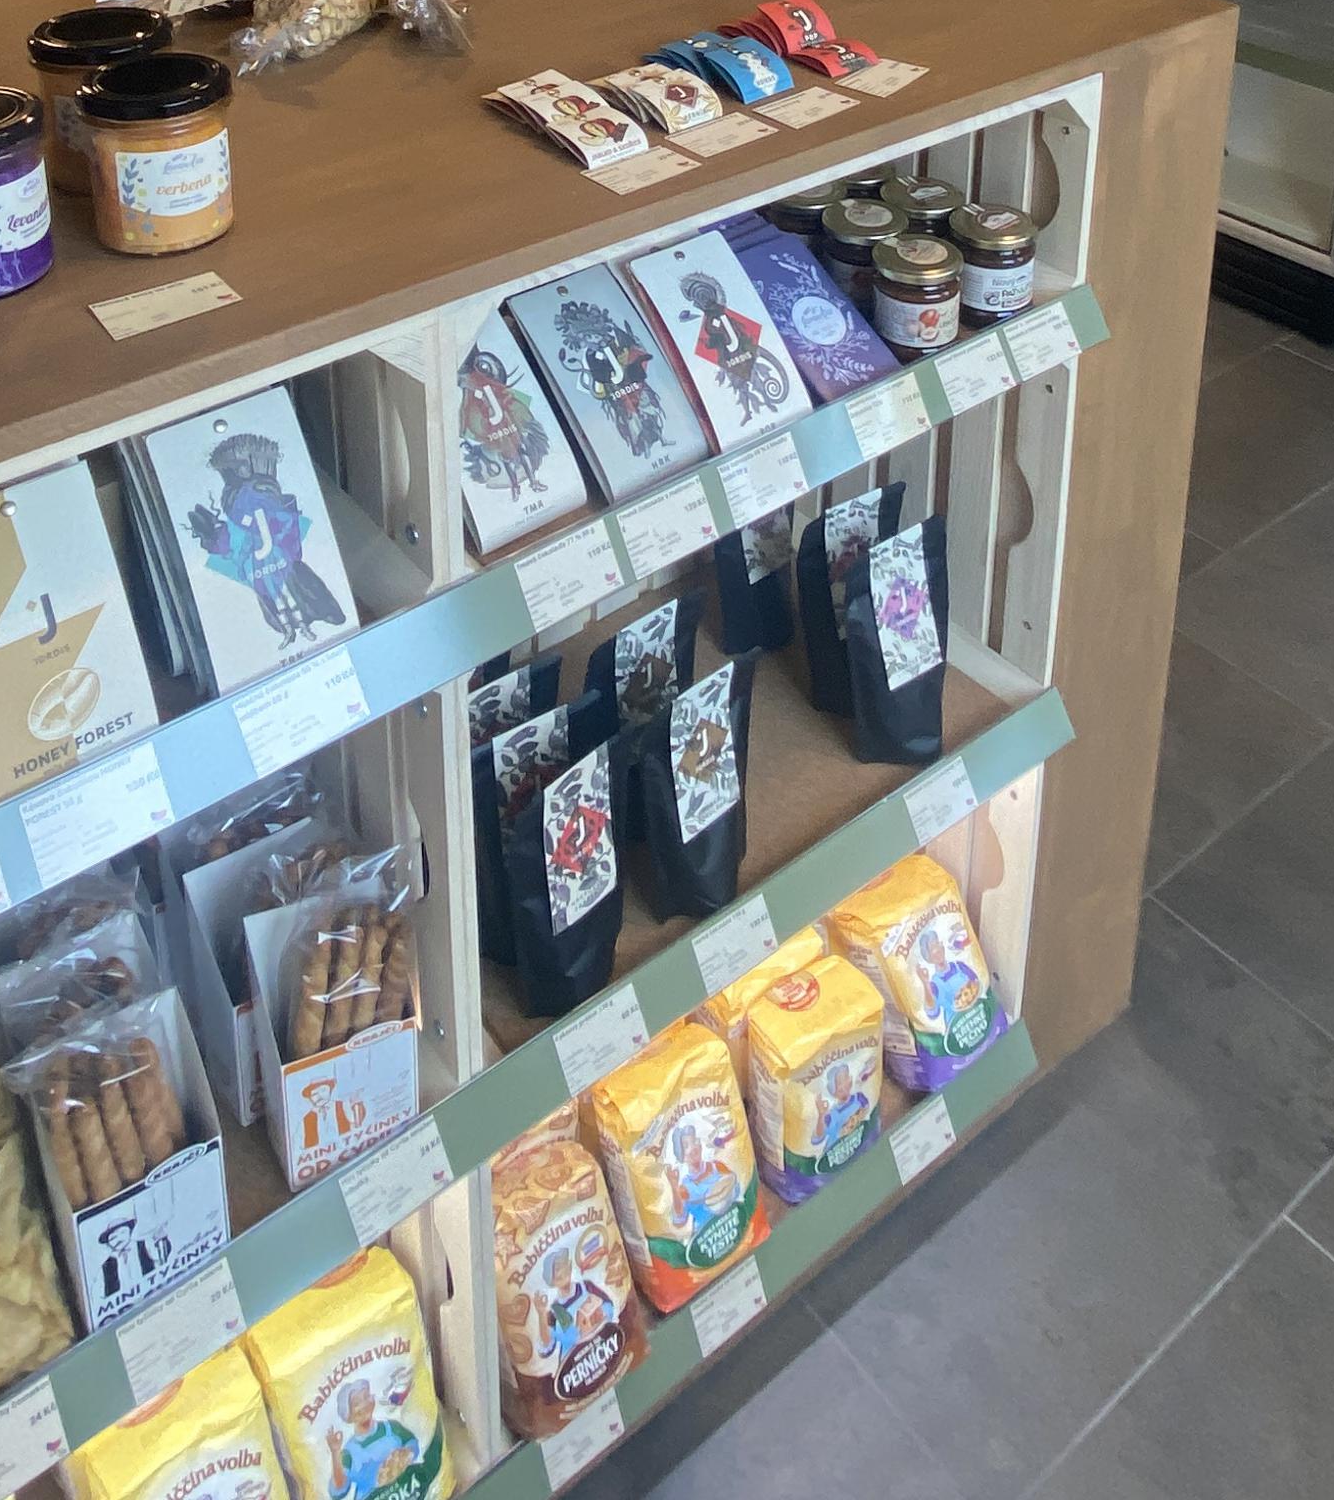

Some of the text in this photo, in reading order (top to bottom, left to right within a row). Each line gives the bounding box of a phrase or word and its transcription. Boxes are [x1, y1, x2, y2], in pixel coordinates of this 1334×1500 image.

[155, 174, 212, 196] verbena
[7, 195, 49, 232] Levand
[610, 382, 641, 401] JORDIS
[487, 424, 517, 442] JORDIS
[523, 500, 545, 516] TMA
[12, 711, 134, 779] HONEY FOREST
[297, 1142, 337, 1166] MINI
[297, 1159, 332, 1180] OD
[507, 1206, 604, 1289] Babiččina volba
[97, 1284, 141, 1318] MINI
[298, 1349, 373, 1424] Babiččina
[217, 1448, 262, 1473] volba
